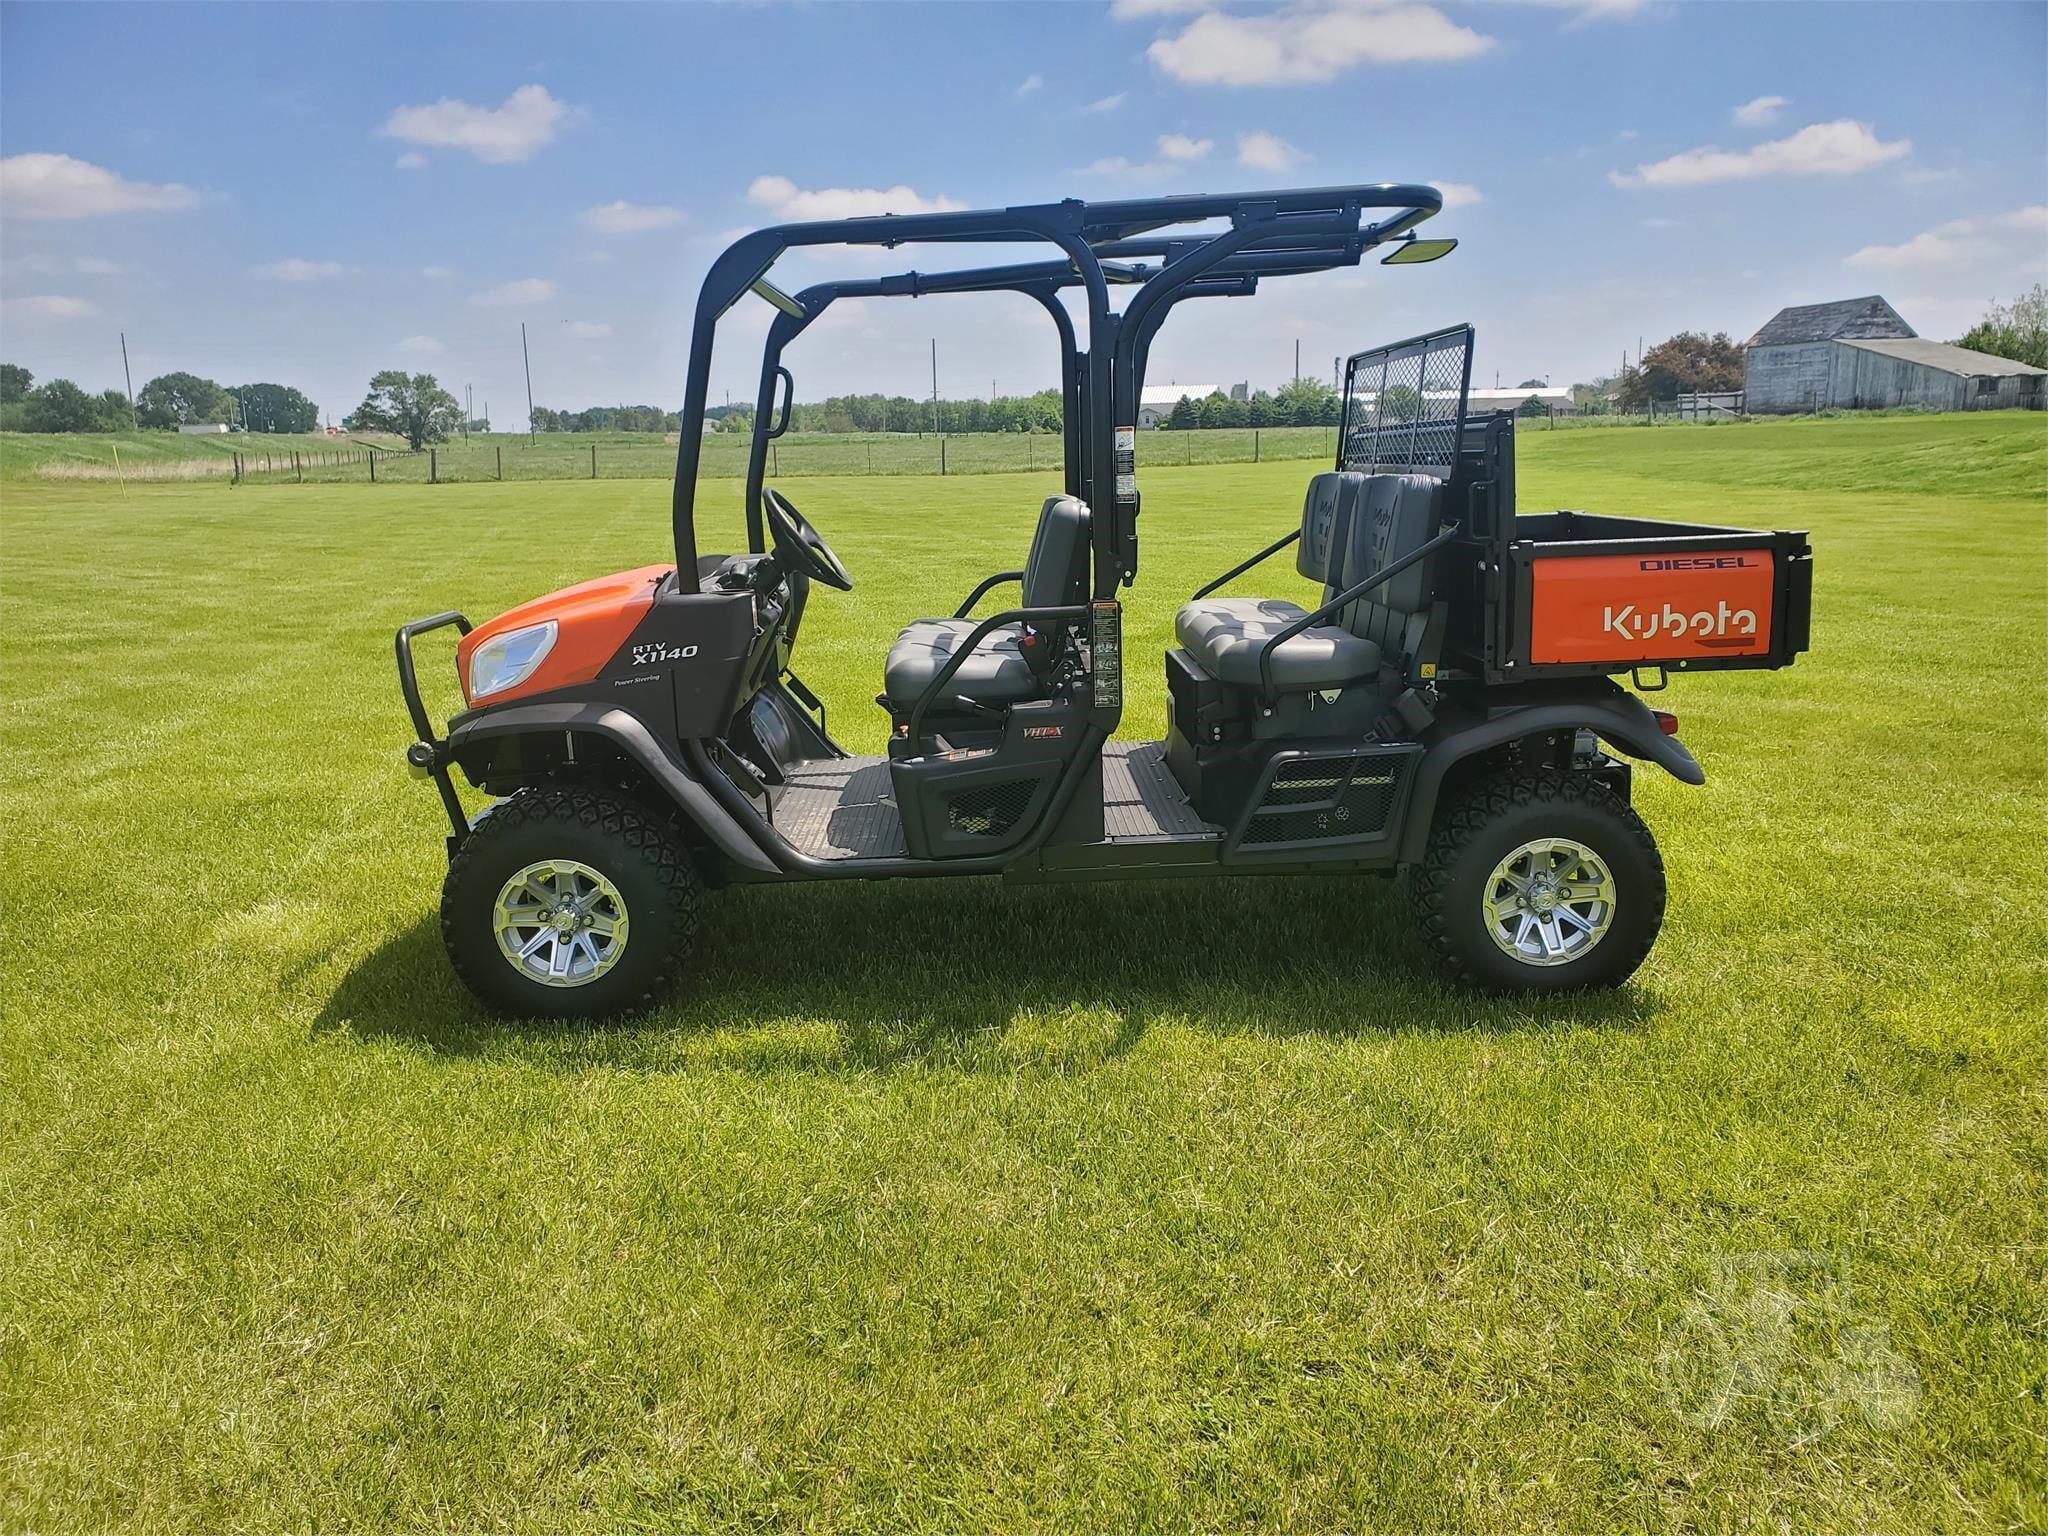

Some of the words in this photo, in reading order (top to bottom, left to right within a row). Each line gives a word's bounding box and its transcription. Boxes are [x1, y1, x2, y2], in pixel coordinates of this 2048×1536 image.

[1640, 557, 1758, 571] DIESEL
[1604, 600, 1756, 640] Kubota
[633, 642, 666, 654] RTV
[632, 645, 698, 666] X1140
[614, 679, 634, 687] Power
[634, 675, 660, 683] Steering
